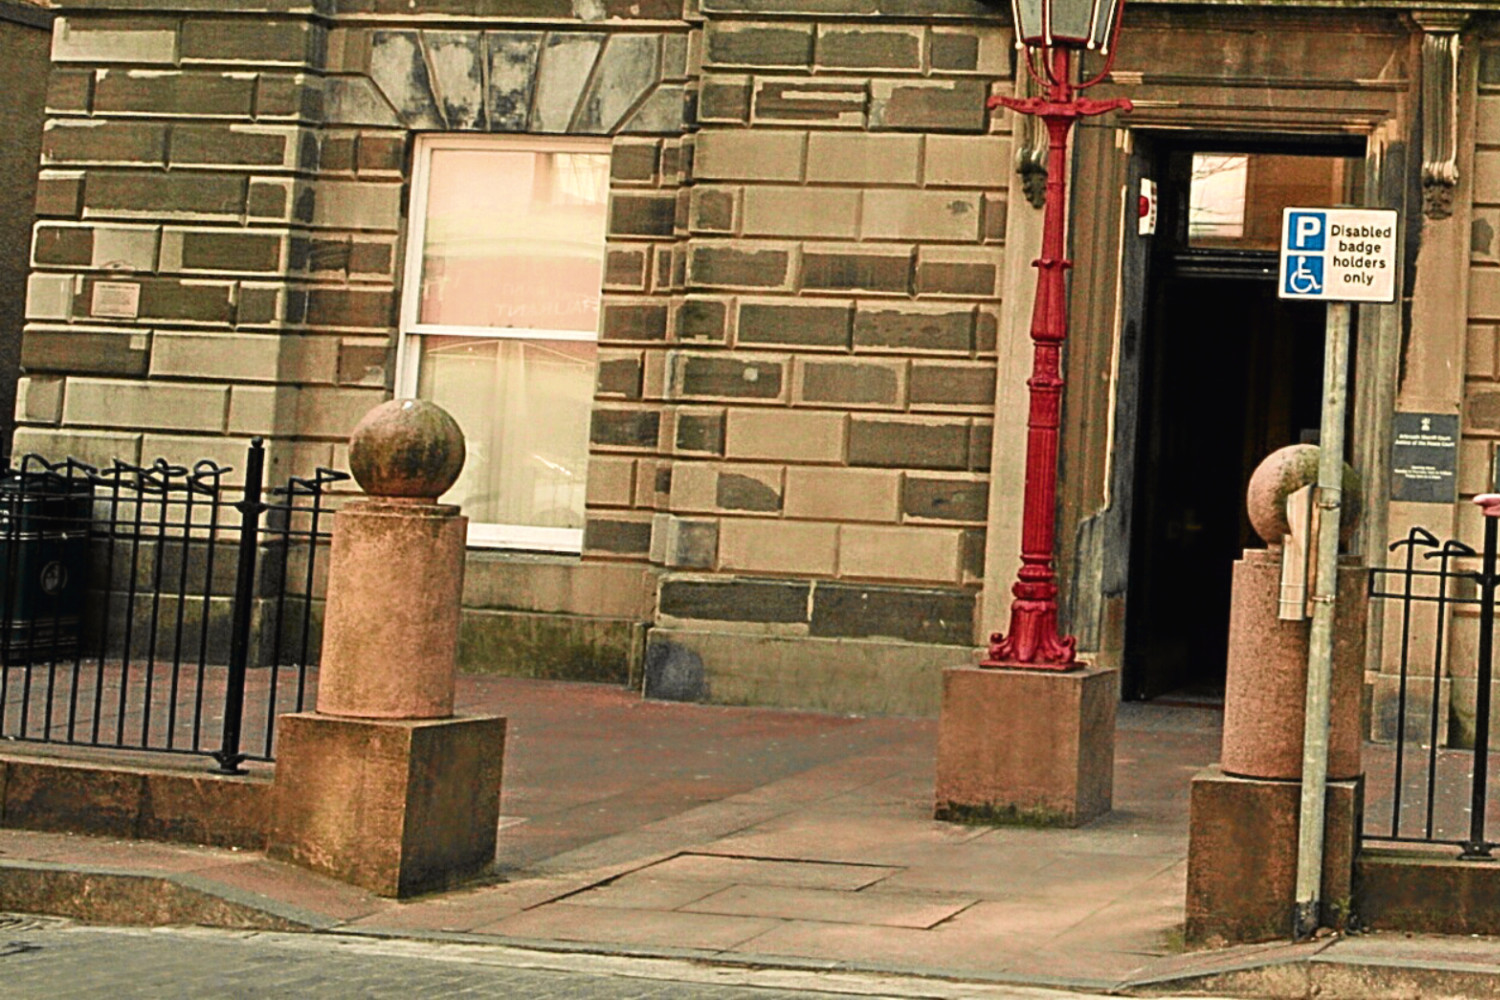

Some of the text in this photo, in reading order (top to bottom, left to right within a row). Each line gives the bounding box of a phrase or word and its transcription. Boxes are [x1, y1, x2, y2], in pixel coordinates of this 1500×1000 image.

[1296, 216, 1321, 247] P
[1331, 225, 1391, 238] Disabled
[1339, 240, 1381, 255] badge
[1333, 256, 1386, 269] holders
[1343, 272, 1374, 286] only
